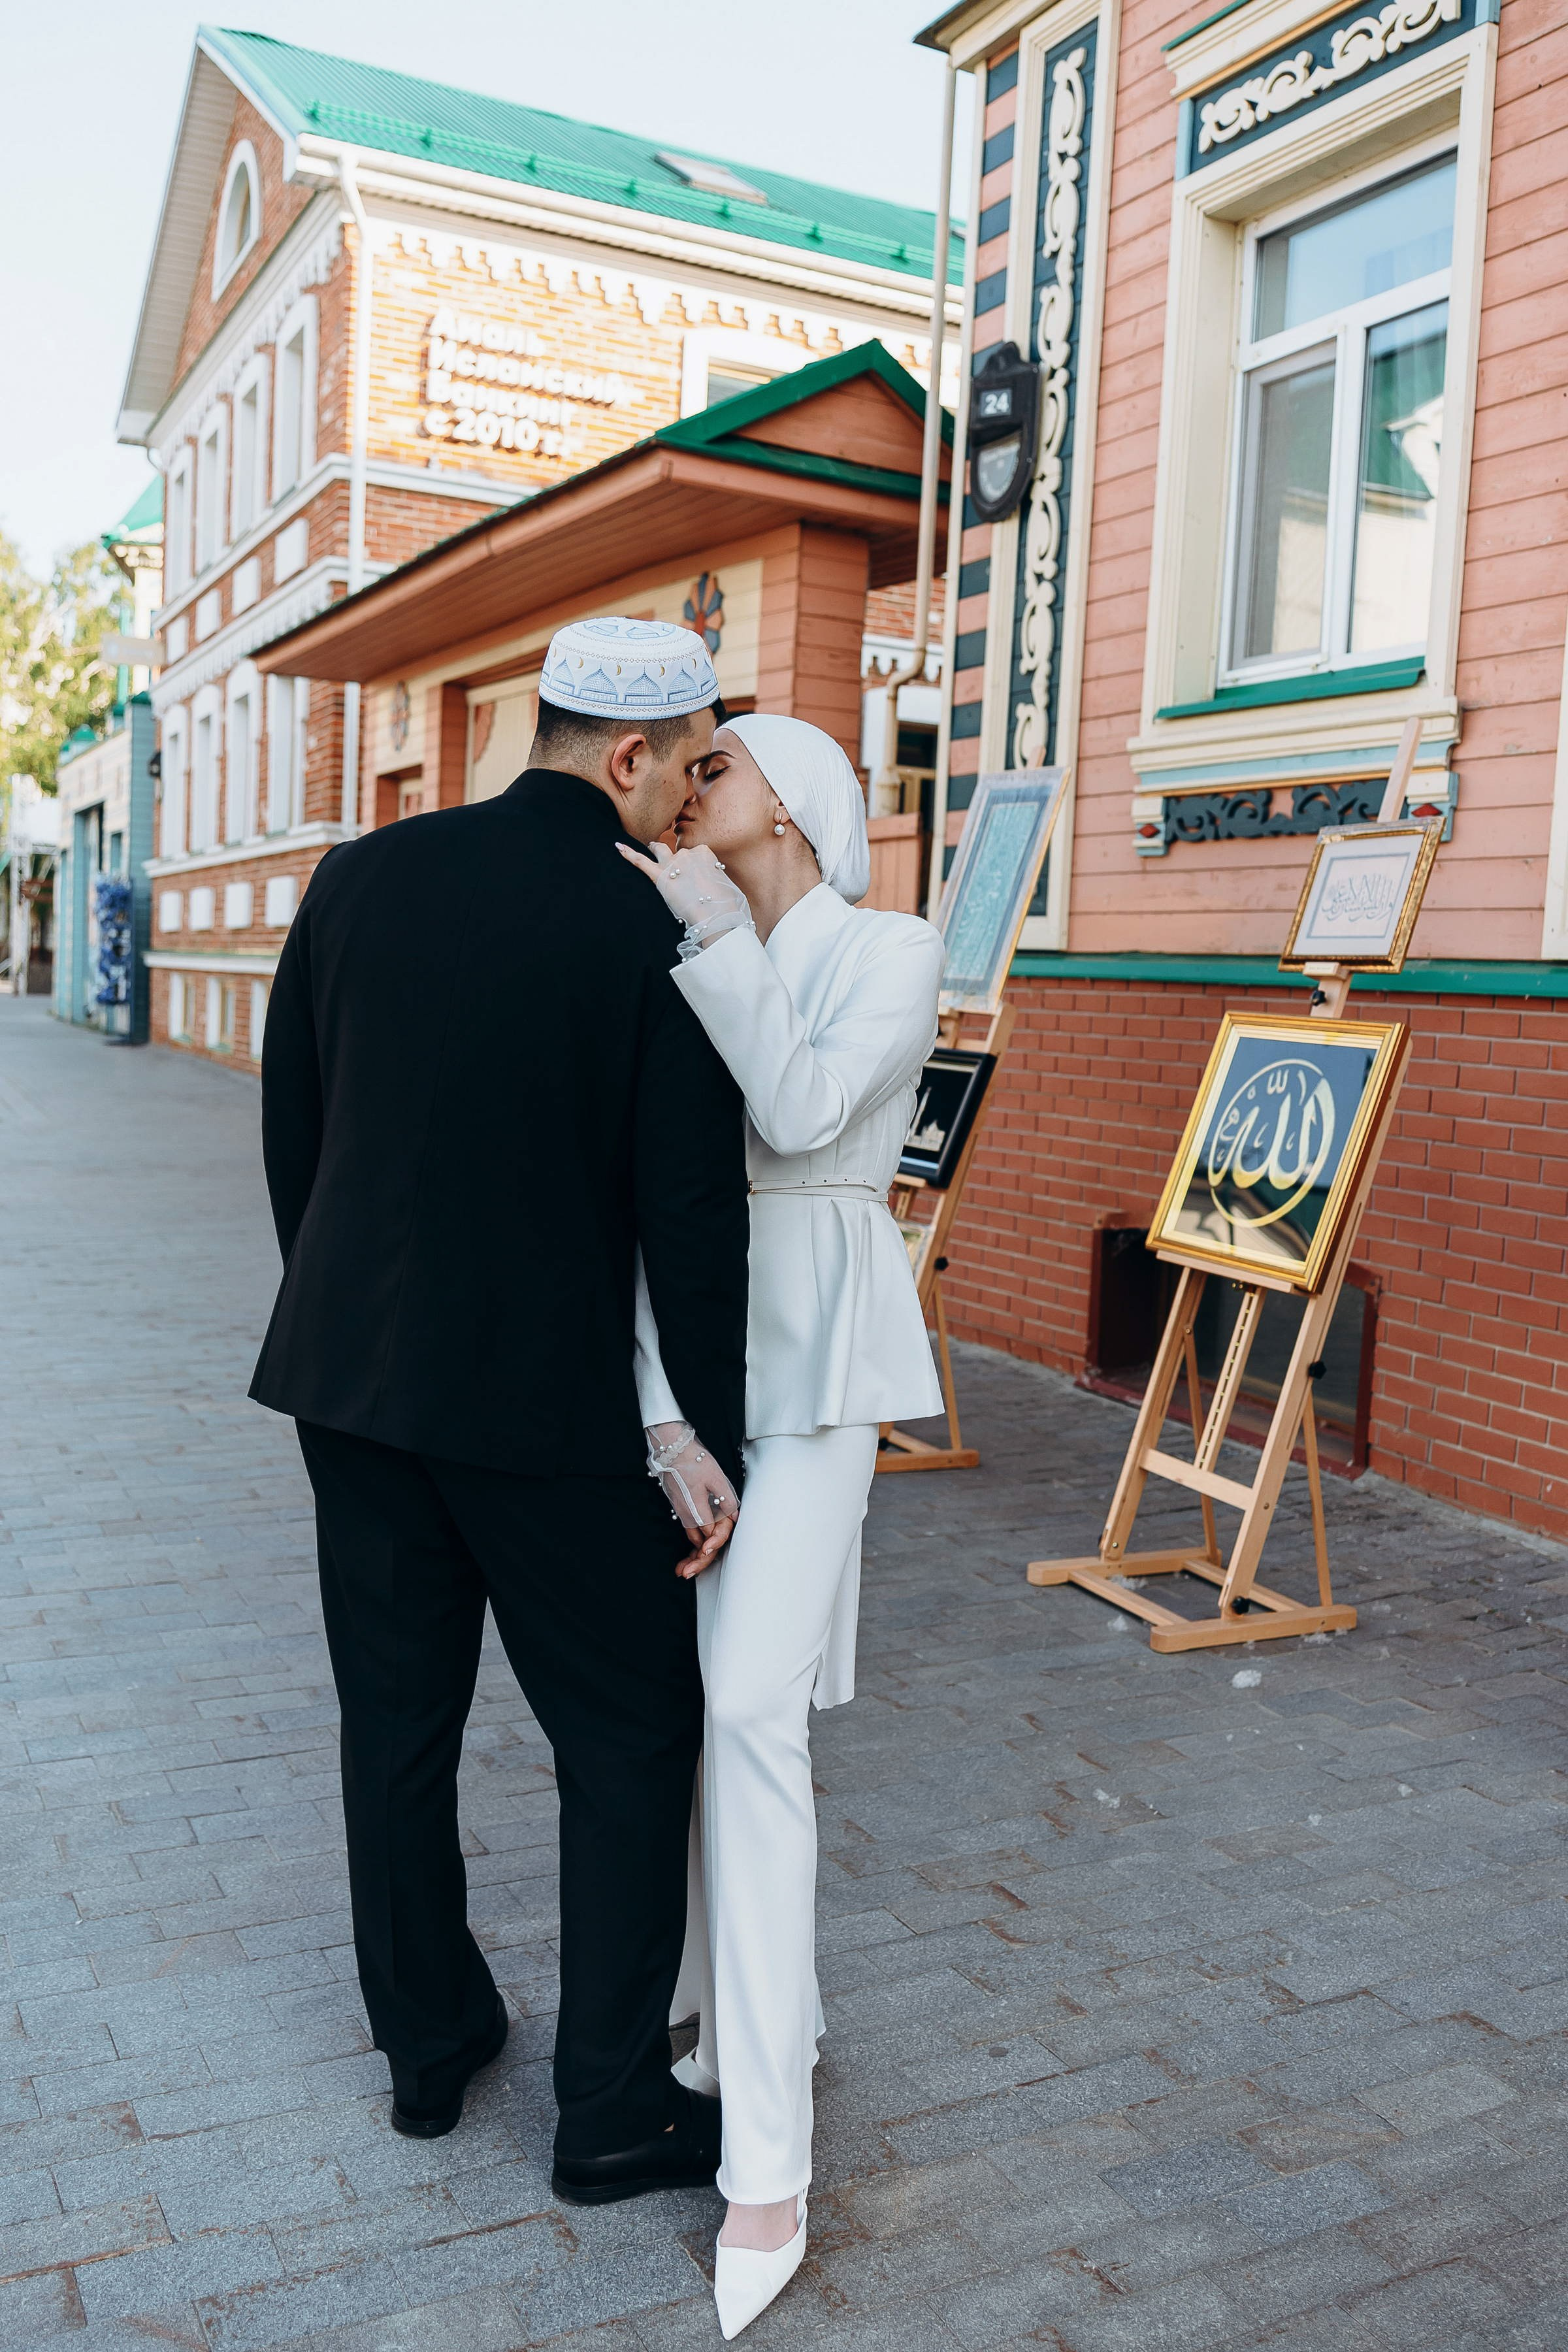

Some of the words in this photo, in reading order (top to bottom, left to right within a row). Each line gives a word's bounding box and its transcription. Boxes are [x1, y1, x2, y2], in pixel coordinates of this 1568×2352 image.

[430, 306, 546, 356] Амаль
[985, 392, 1009, 415] 24
[425, 410, 449, 435] с
[453, 407, 540, 451] 2010
